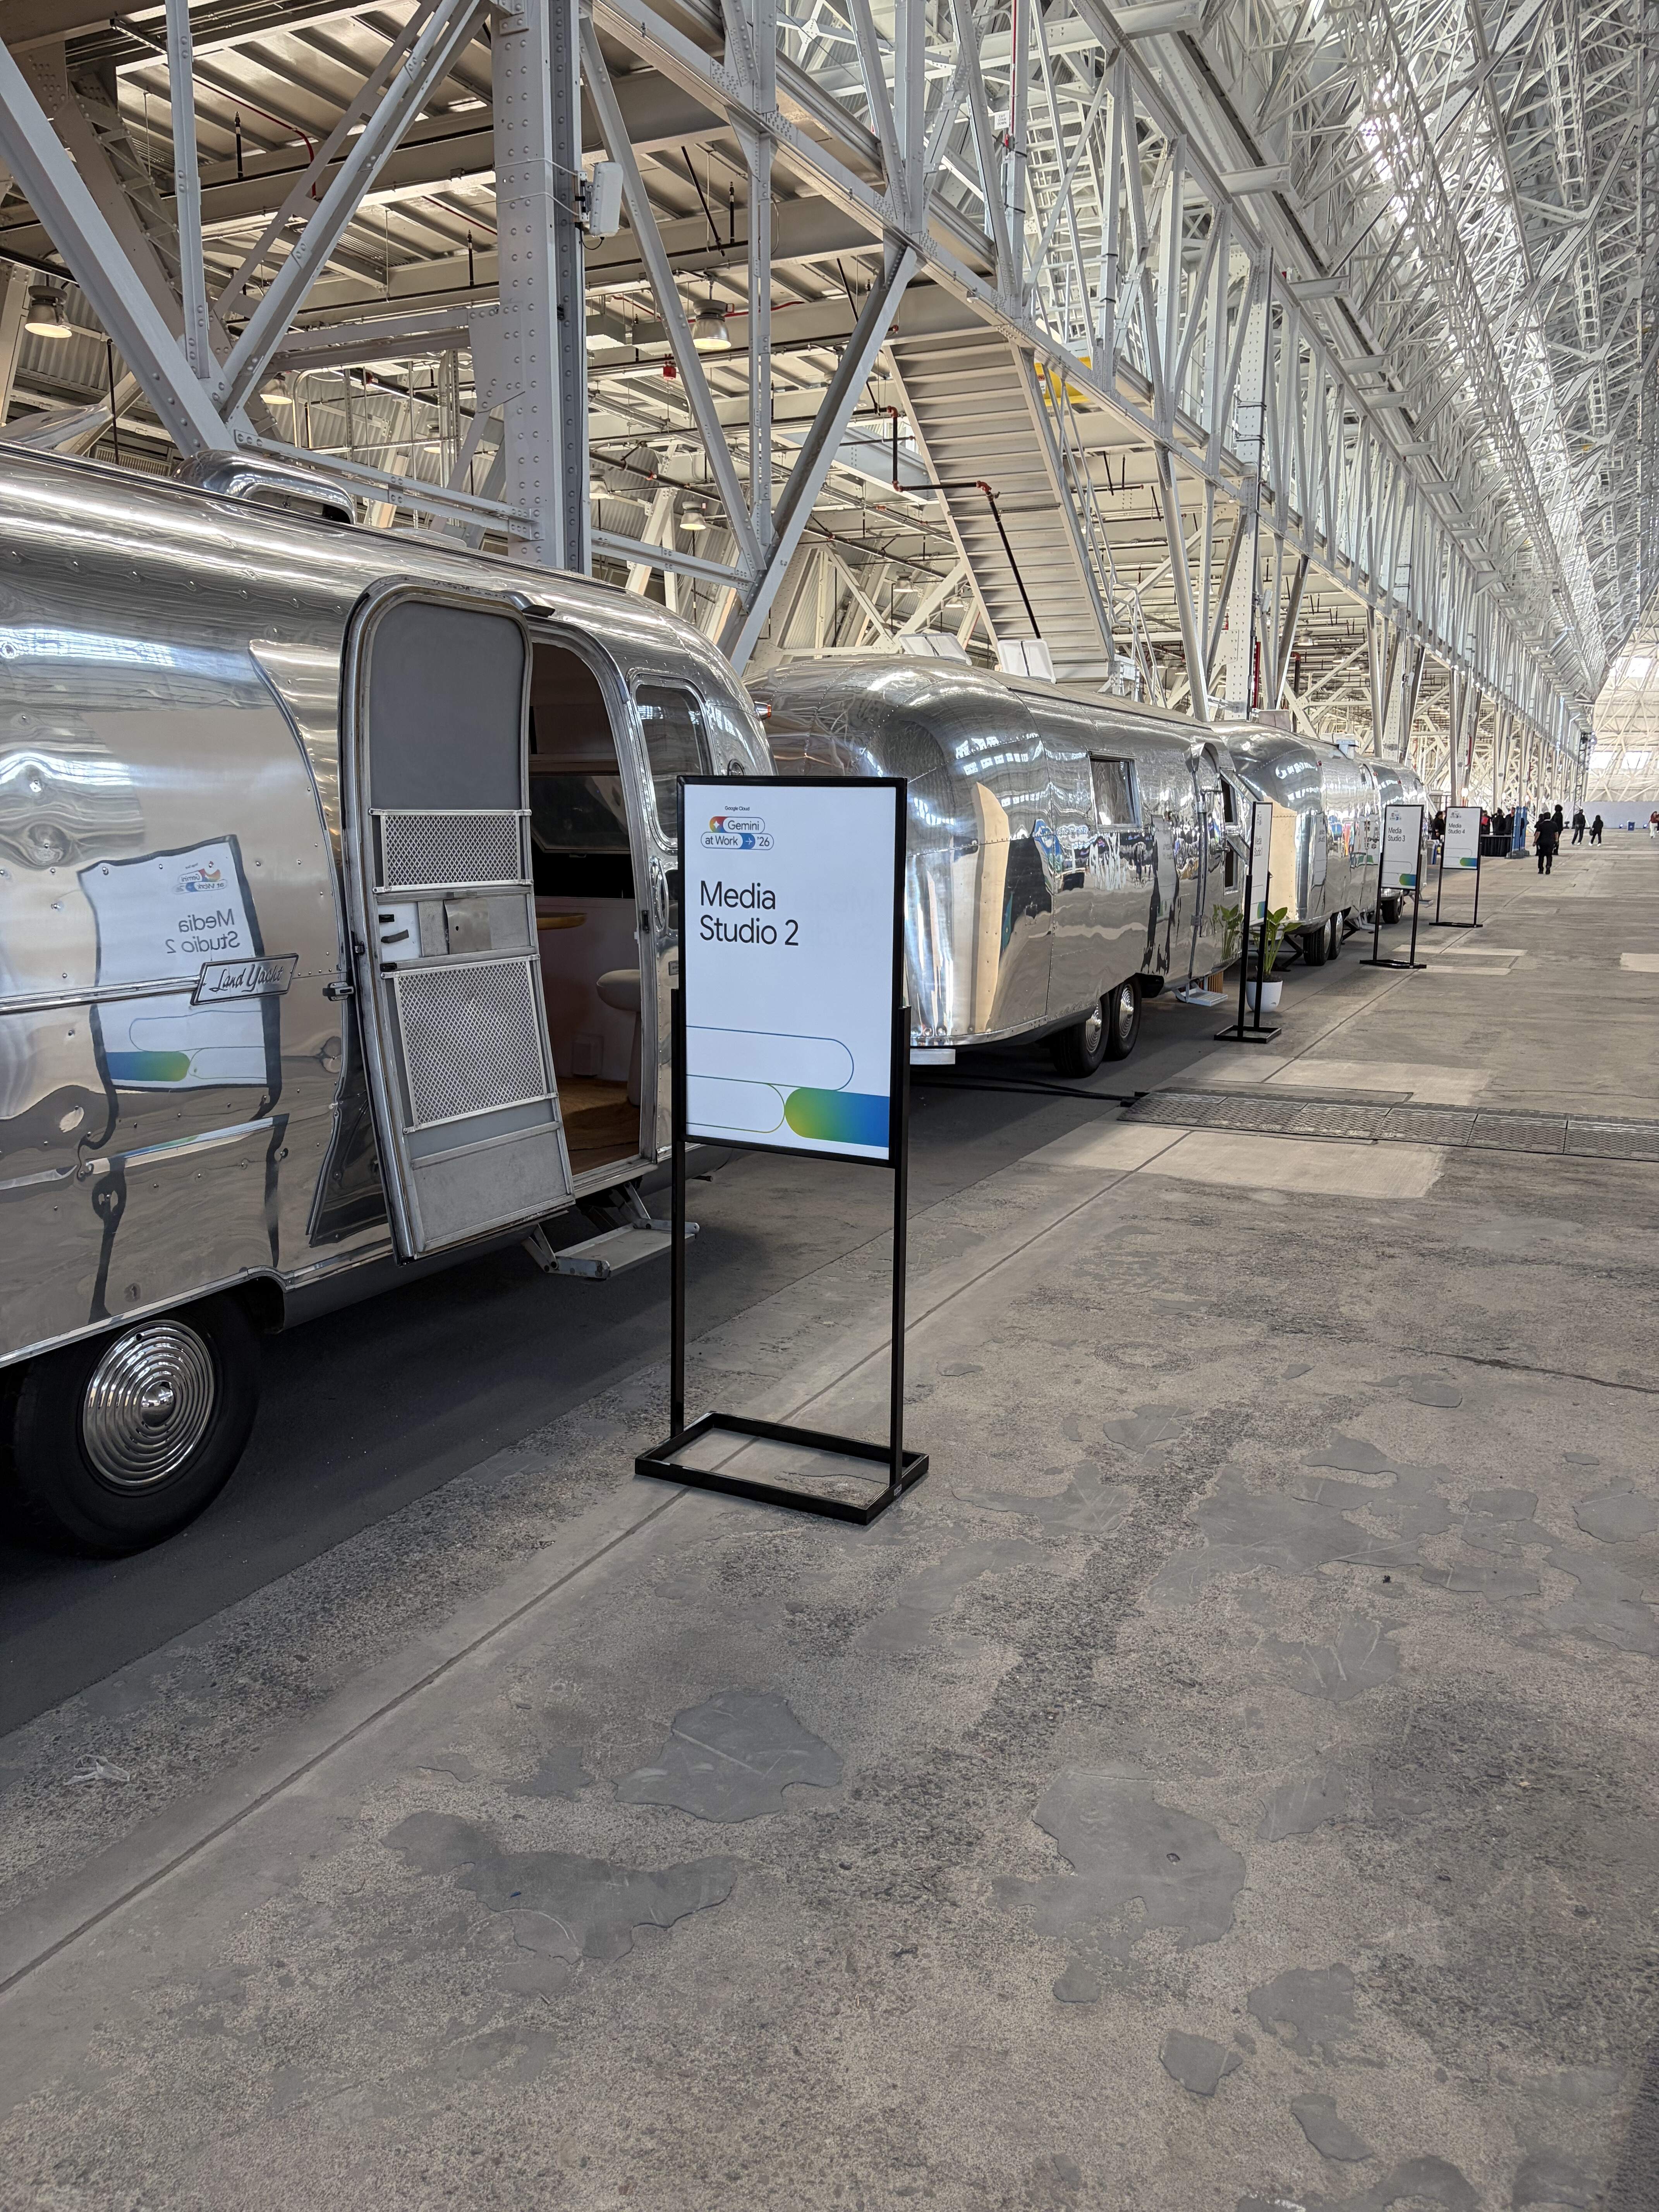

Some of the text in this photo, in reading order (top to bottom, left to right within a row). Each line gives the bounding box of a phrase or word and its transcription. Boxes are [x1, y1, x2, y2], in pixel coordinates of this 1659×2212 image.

[728, 820, 759, 831] Gemini
[705, 836, 713, 845] at
[715, 835, 738, 846] Work
[701, 880, 776, 910] Media
[699, 914, 799, 946] Studio 2
[208, 964, 283, 992] Land Yacht
